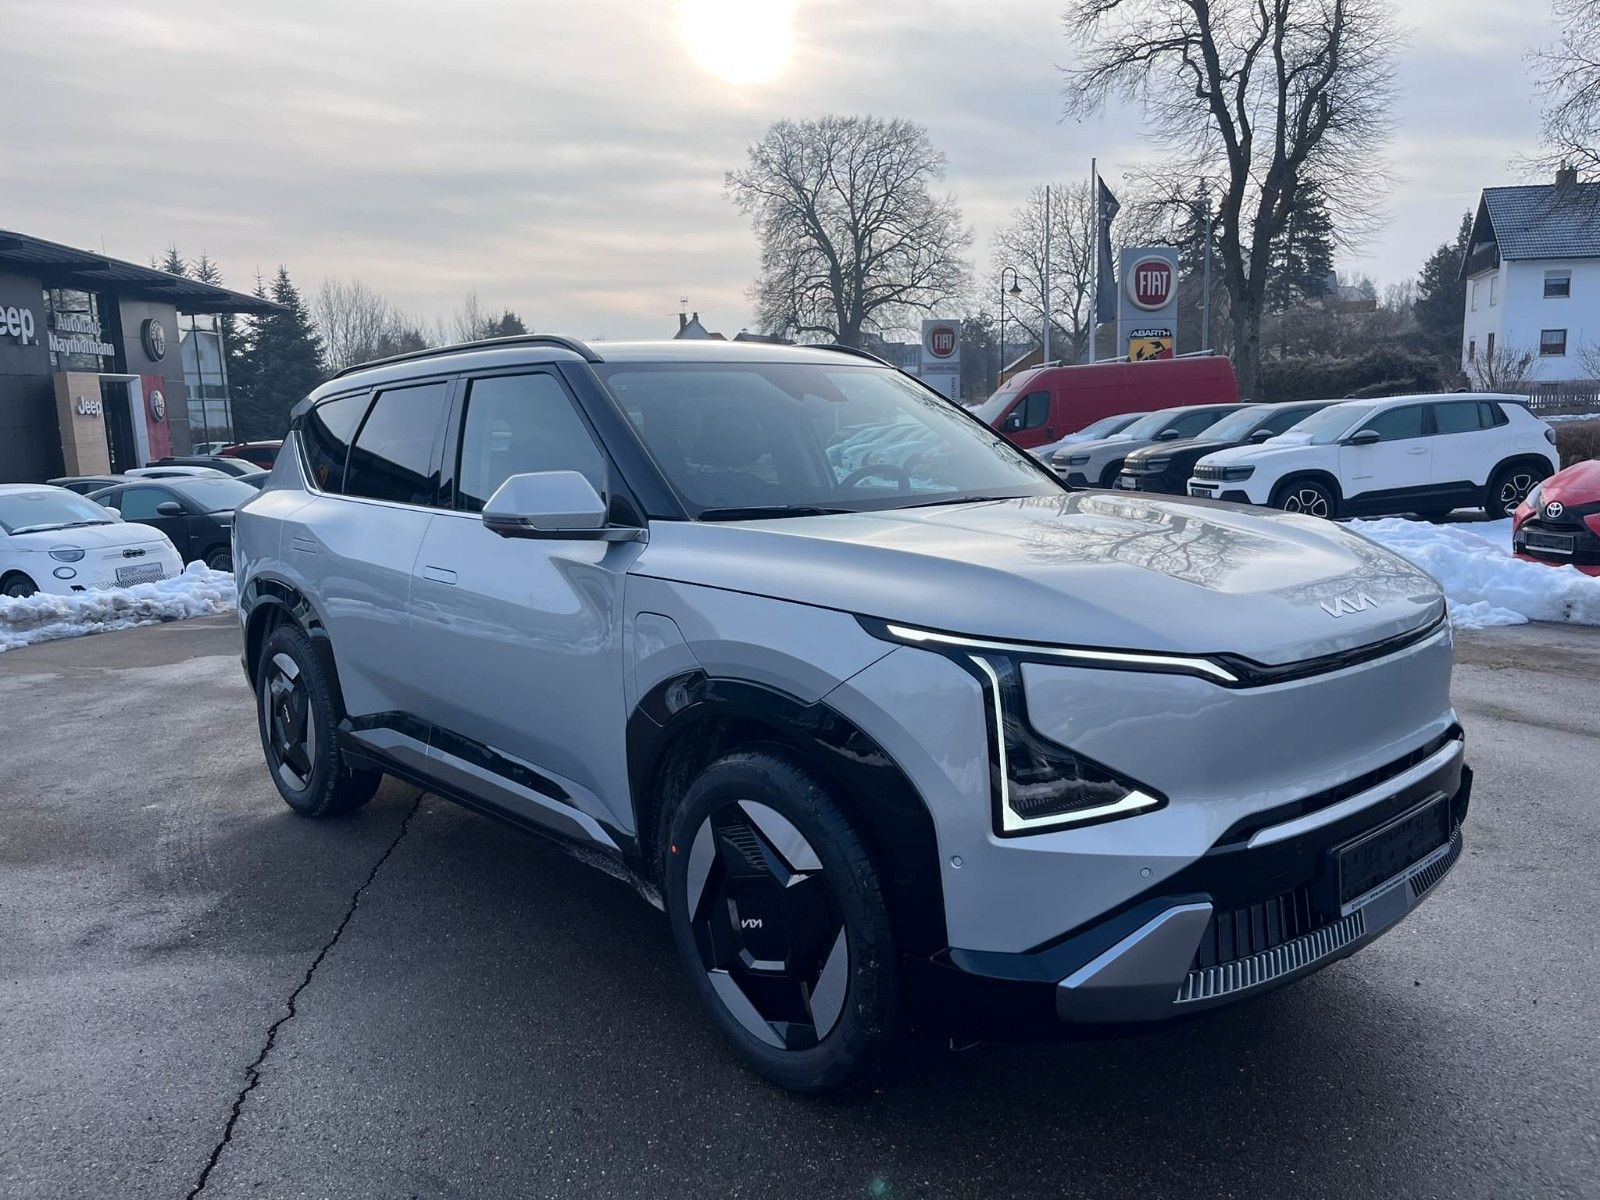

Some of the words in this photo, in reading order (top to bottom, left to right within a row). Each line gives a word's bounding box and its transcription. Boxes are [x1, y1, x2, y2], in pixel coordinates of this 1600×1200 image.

[1139, 271, 1168, 296] FIAT
[58, 314, 102, 336] Autohaus
[1131, 329, 1170, 337] ABARTH
[934, 333, 953, 349] FIAT
[79, 395, 102, 417] Jeep
